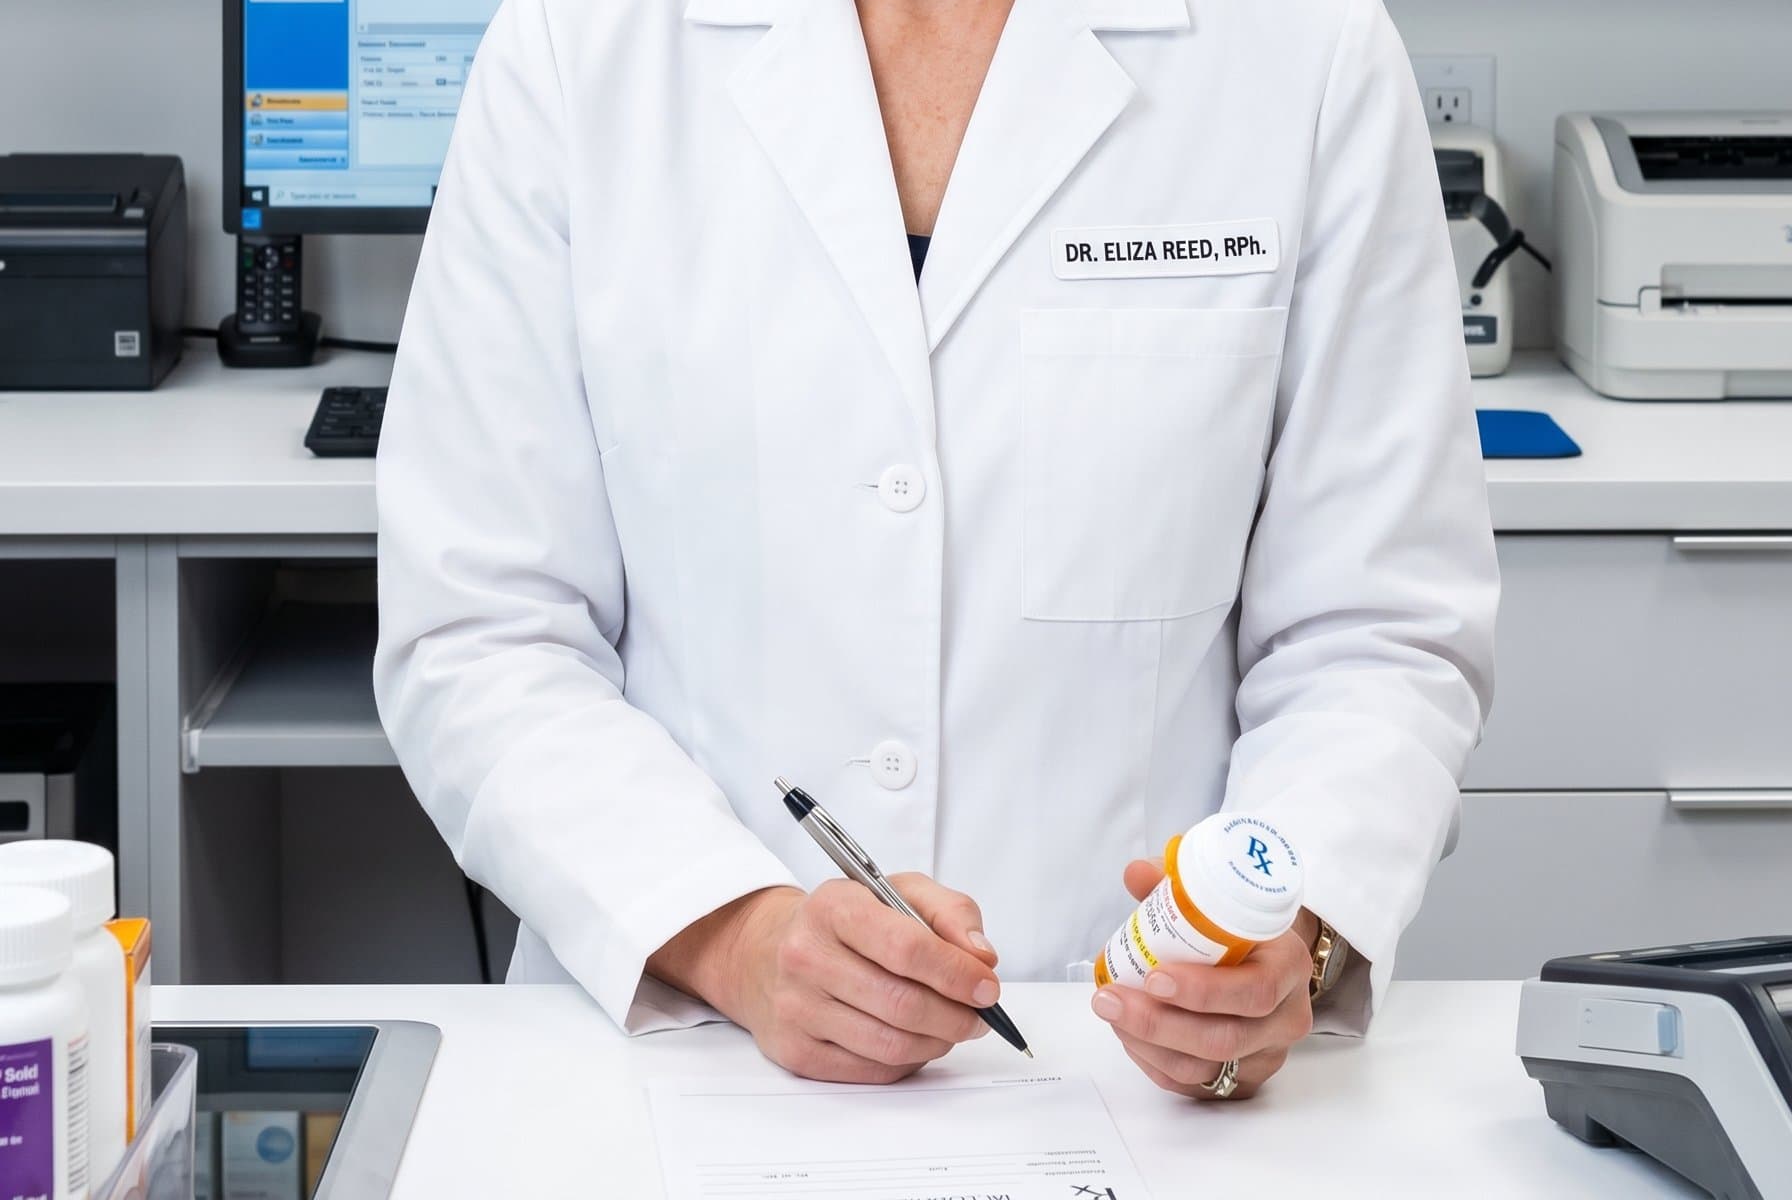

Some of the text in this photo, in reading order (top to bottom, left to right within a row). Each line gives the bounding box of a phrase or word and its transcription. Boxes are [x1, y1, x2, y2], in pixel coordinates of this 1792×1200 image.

[1065, 235, 1267, 262] DR. ELIZA REED, RPh.
[1246, 836, 1273, 876] Rx
[5, 1064, 39, 1084] Sold
